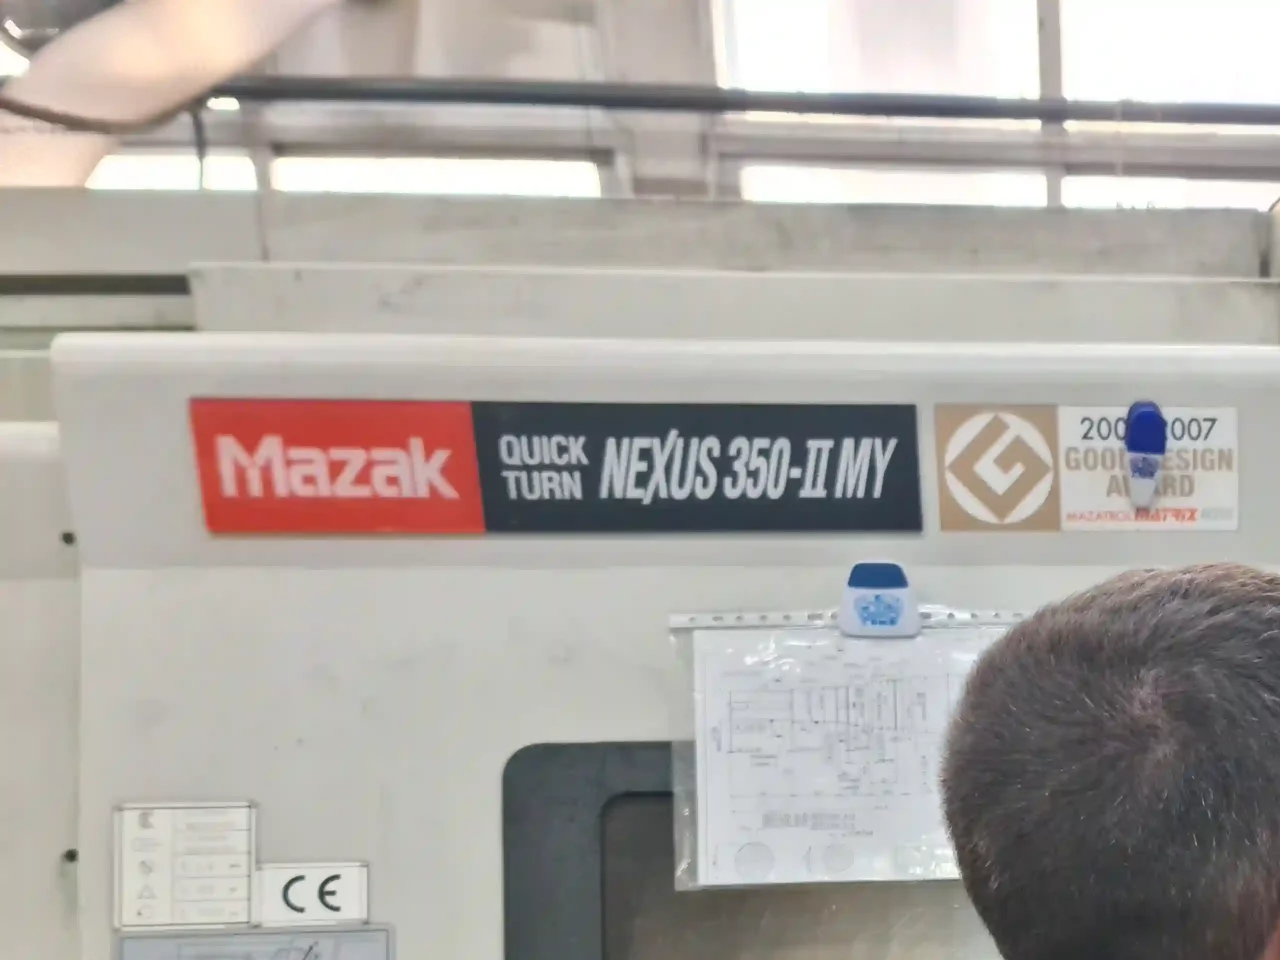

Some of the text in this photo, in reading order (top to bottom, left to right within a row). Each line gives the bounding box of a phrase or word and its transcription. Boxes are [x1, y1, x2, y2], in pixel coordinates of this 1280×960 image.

[1080, 416, 1219, 441] 200 007
[499, 435, 589, 466] QUICK
[1162, 447, 1234, 471] ESIGN
[214, 433, 460, 499] Mazak
[600, 428, 721, 505] NEXUS
[835, 437, 898, 499] MY
[501, 470, 583, 500] TURN
[1134, 506, 1198, 522] MATRIX
[282, 874, 341, 914] CE
